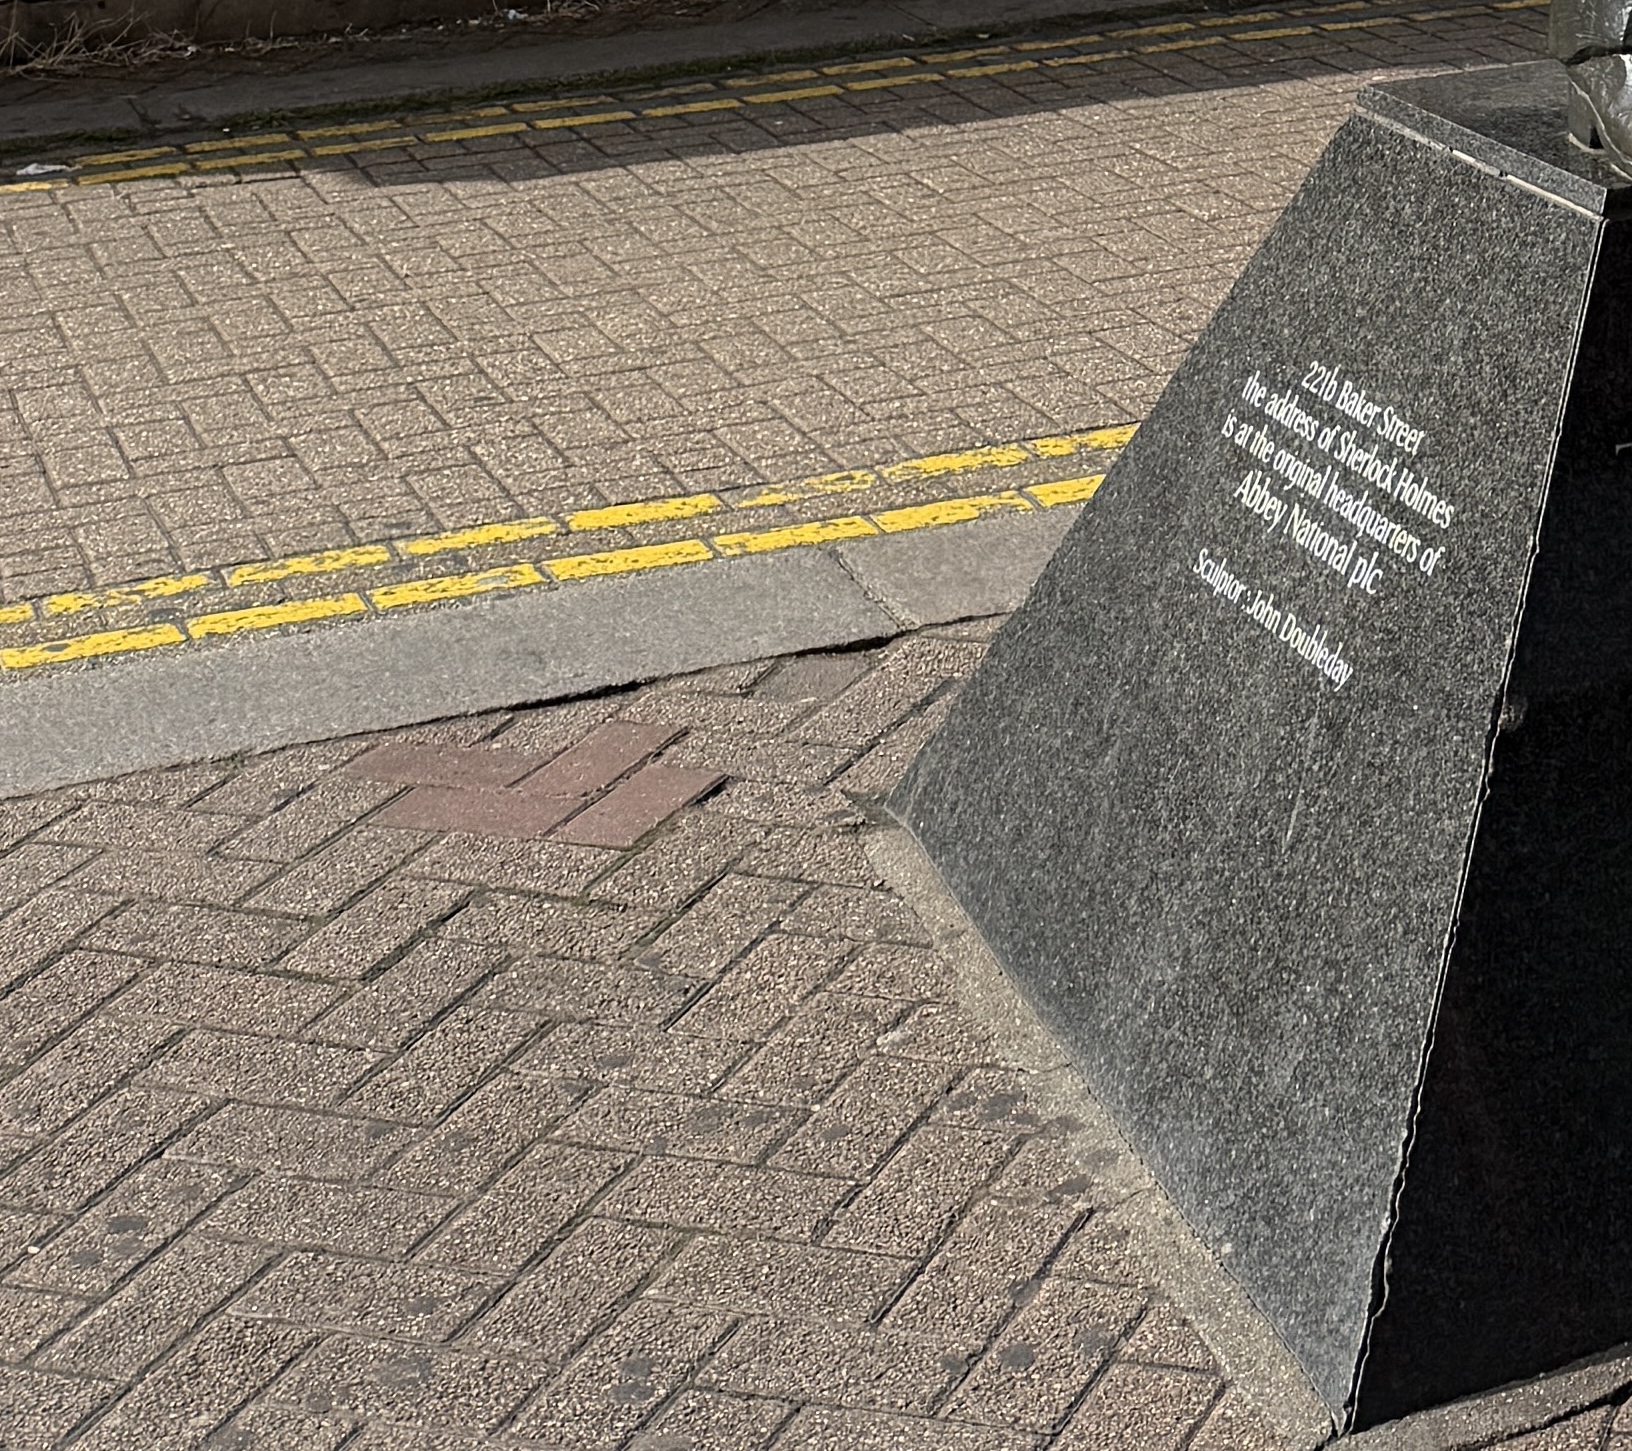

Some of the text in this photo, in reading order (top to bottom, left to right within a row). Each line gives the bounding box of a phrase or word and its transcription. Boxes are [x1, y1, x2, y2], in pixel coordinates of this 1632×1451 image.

[1241, 370, 1455, 530] the address of Sherlock Holmes
[1301, 360, 1426, 457] 221b Baker Street
[1220, 408, 1446, 577] is at the original headquarters of
[1233, 470, 1384, 595] Abbey National plc
[1246, 589, 1282, 634] John
[1278, 612, 1354, 692] Doubleday
